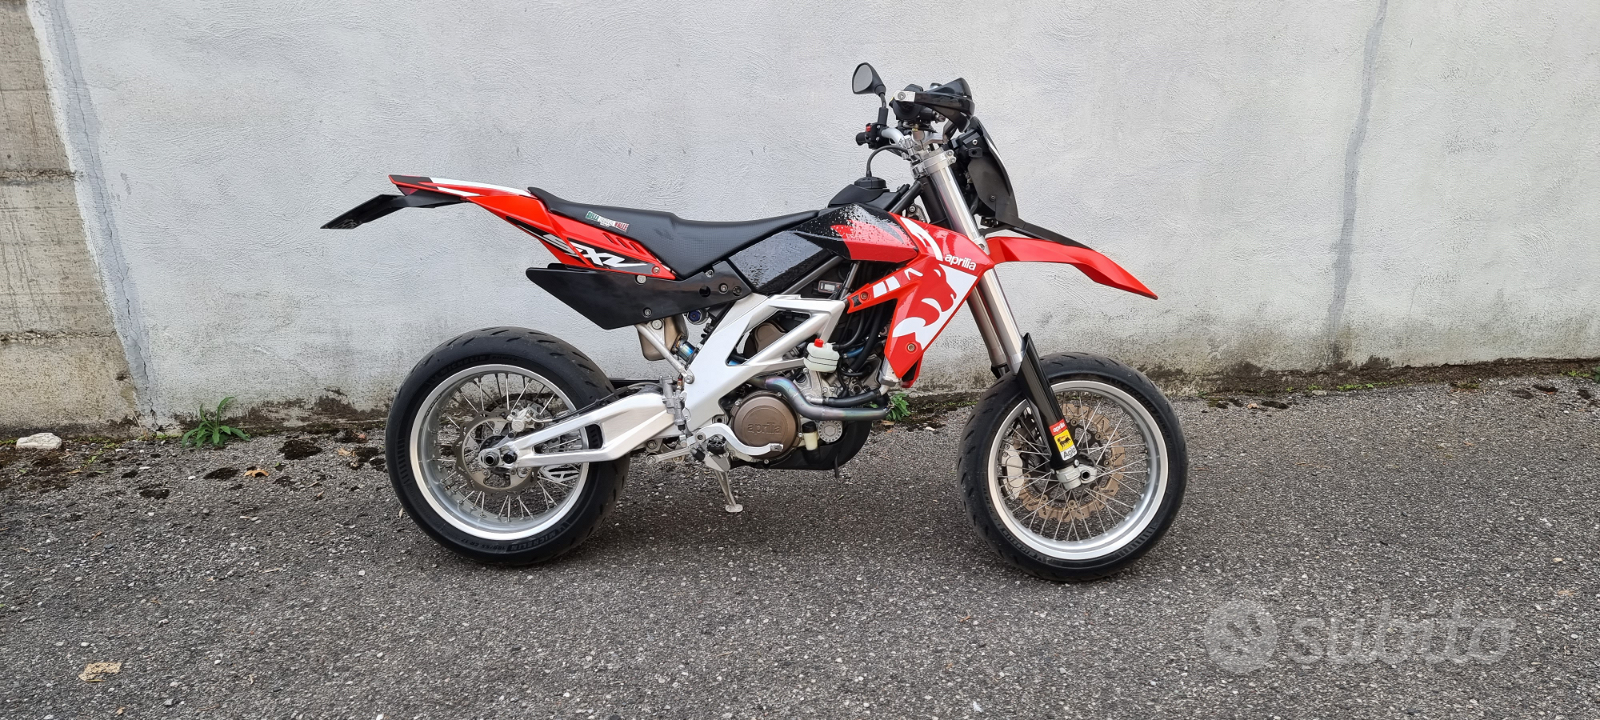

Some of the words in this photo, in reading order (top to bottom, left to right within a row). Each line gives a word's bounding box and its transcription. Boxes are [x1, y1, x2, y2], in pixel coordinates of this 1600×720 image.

[944, 253, 977, 271] aprilia
[440, 355, 486, 375] MICHELIN
[747, 421, 782, 435] aprilia
[510, 527, 557, 551] MICHELIN
